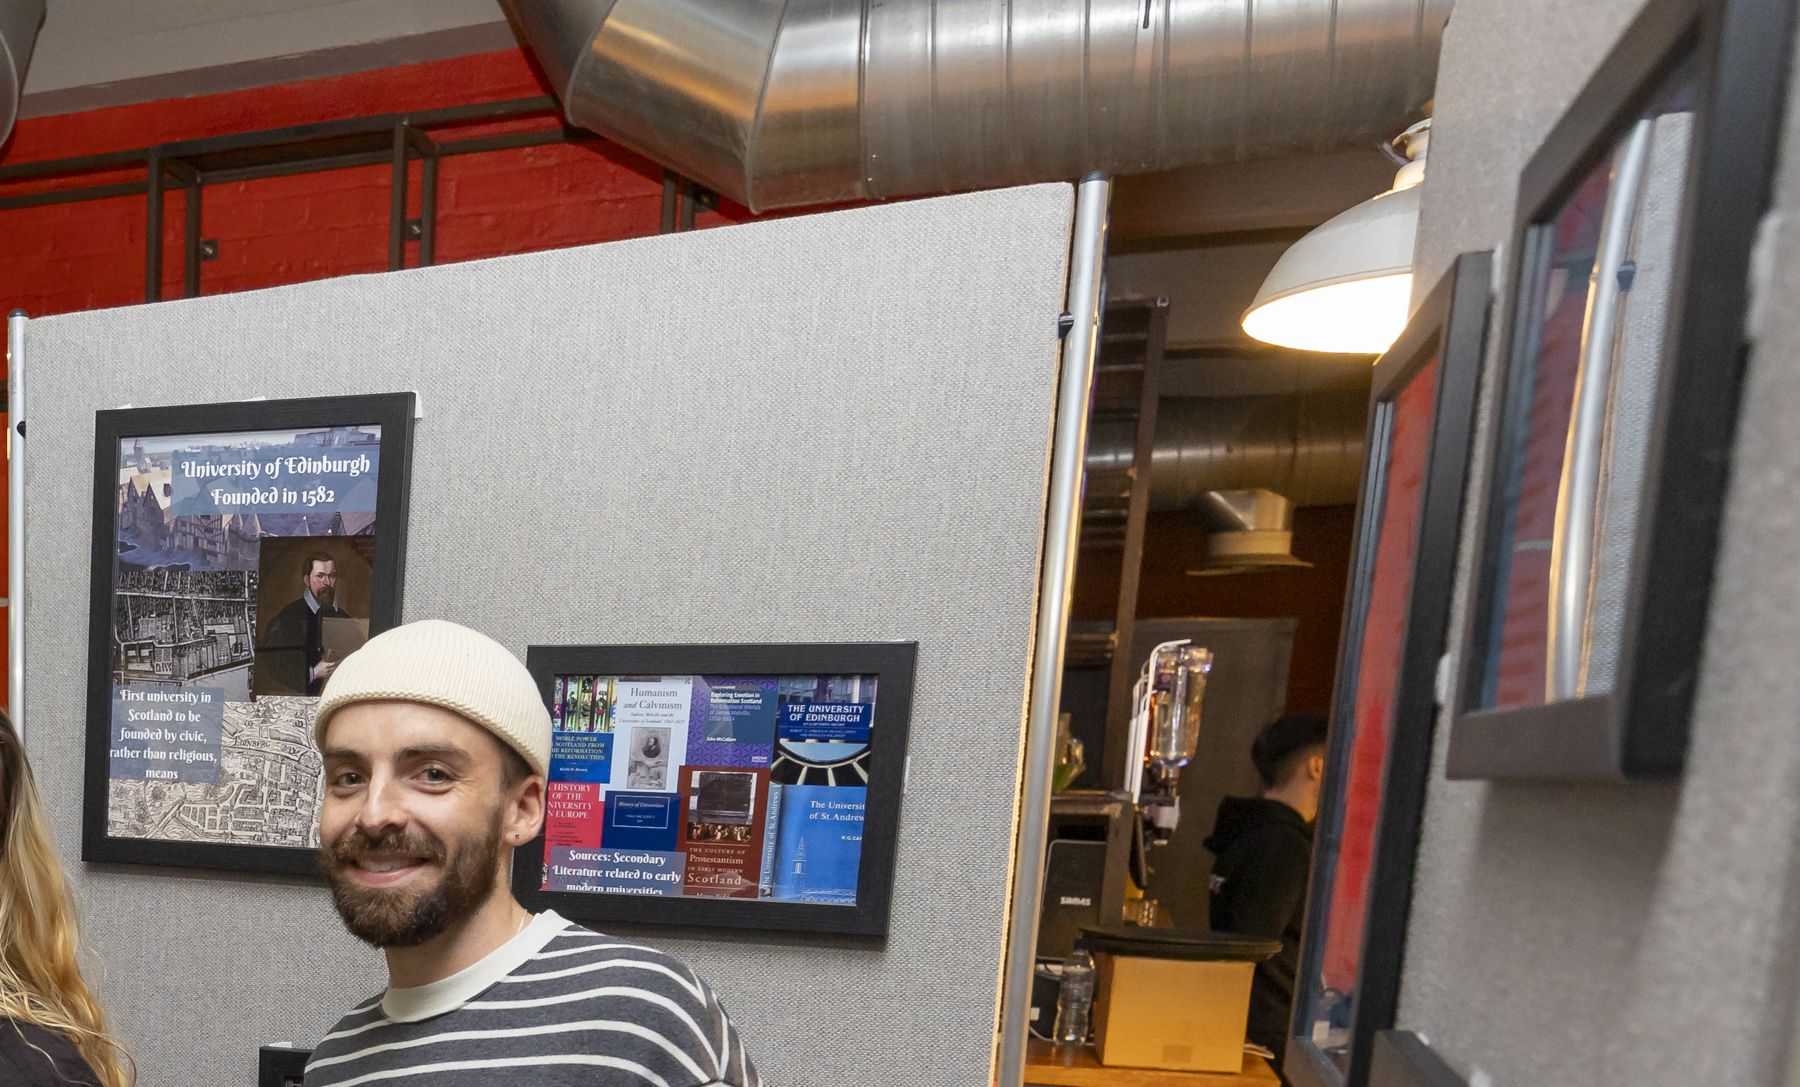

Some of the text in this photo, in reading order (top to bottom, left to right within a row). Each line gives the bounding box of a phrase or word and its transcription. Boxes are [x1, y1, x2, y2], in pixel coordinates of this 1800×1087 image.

[181, 454, 370, 480] University of Edinburgh
[211, 486, 335, 507] Founded in 1582
[120, 689, 211, 706] First university in
[630, 688, 678, 697] Humanism
[639, 700, 682, 709] Calvinism
[788, 704, 864, 713] THE UNIVERSITY
[128, 709, 201, 722] Scotland to be
[789, 713, 860, 722] OF EDINBURGH
[118, 727, 207, 744] founded by civic,
[110, 746, 218, 764] rather than religious,
[145, 769, 178, 779] means
[554, 784, 592, 792] HISTORY
[548, 801, 592, 810] NIVERSITY
[810, 800, 865, 810] The Universit
[555, 810, 589, 819] EUROPE
[809, 812, 819, 820] of
[833, 813, 865, 821] Andrew
[569, 849, 666, 867] Sources: Secondary
[690, 854, 744, 864] Protestantism
[764, 842, 775, 874] University
[552, 864, 681, 884] Literature related to early
[688, 873, 741, 885] Scotland
[566, 882, 664, 895] modern universities
